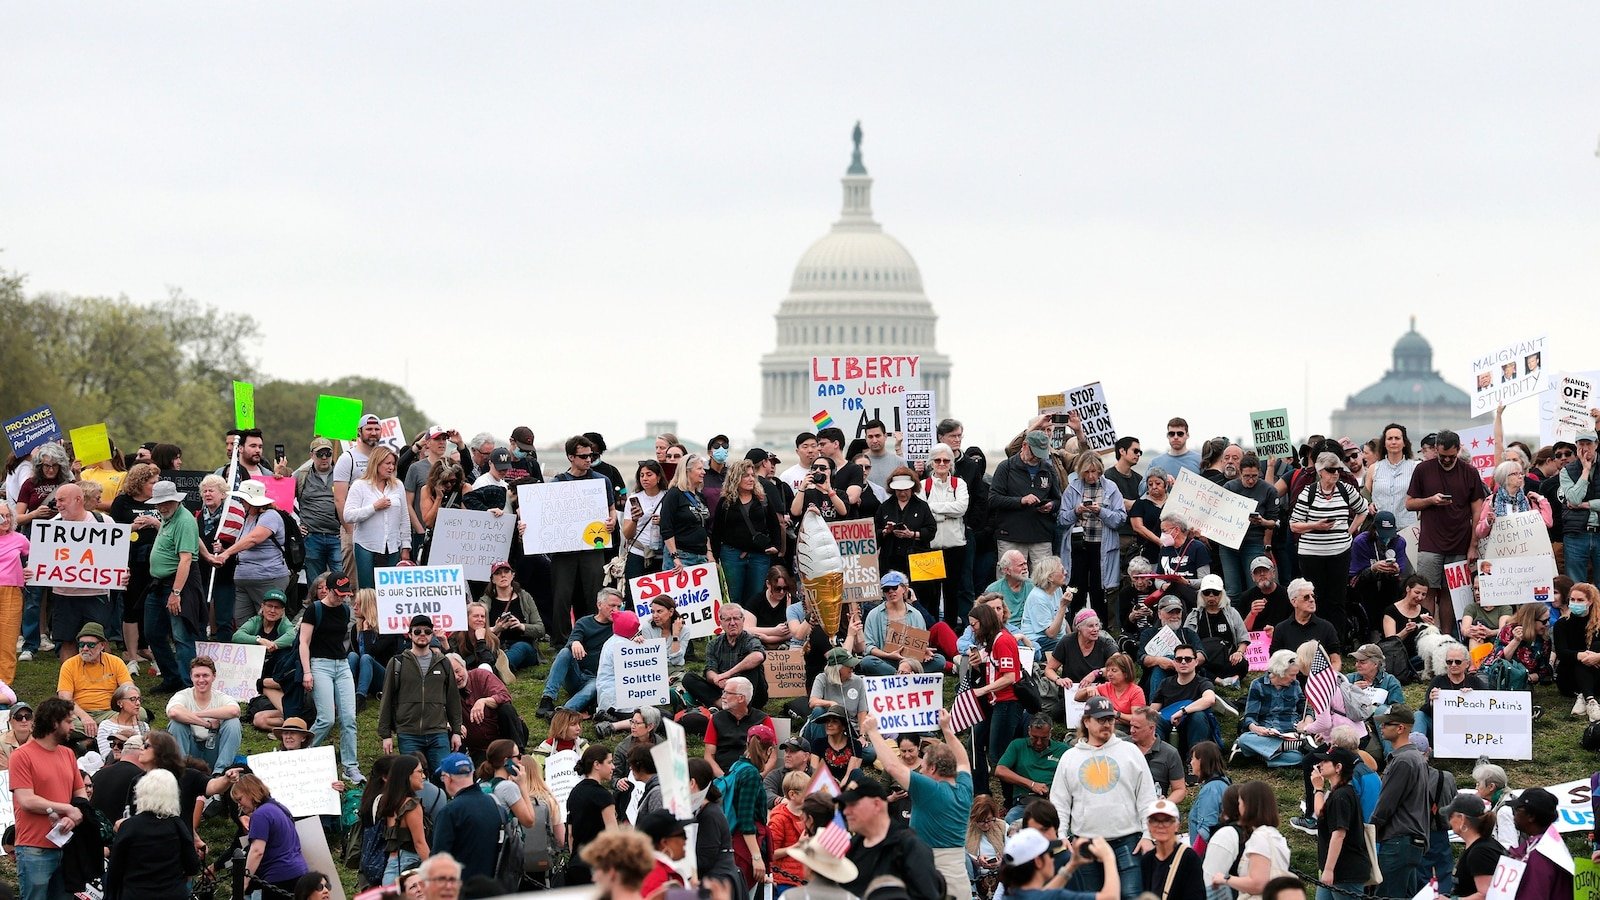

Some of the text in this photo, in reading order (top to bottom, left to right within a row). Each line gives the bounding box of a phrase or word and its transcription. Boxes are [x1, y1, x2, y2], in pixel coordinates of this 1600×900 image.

[1473, 336, 1546, 373] MALIGNANT
[812, 356, 920, 381] LIBERTY
[858, 381, 905, 396] Justice
[1476, 371, 1541, 409] STUPIDITY
[1564, 377, 1590, 389] HANDS
[1070, 387, 1095, 407] STOP
[1563, 386, 1589, 400] OFF
[907, 400, 929, 408] OFF!
[5, 408, 52, 433] PRO-CHOICE
[908, 423, 930, 432] OFF!
[1081, 415, 1112, 435] AR ON
[1253, 416, 1285, 430] WE NEED
[1254, 430, 1286, 443] FEDERAL
[1255, 442, 1289, 457] WORKERS
[1180, 470, 1197, 486] This
[1225, 496, 1237, 504] of
[1238, 500, 1249, 510] the
[1195, 490, 1220, 508] FREE
[443, 518, 505, 530] WHEN YOU PLAY
[1199, 505, 1212, 516] and
[1235, 515, 1245, 529] by
[36, 523, 124, 547] TRUMP
[446, 530, 476, 541] STUPID
[1523, 528, 1533, 537] IN
[460, 542, 496, 552] YOU WIN
[837, 539, 876, 556] ERVES
[54, 547, 94, 566] IS A
[445, 553, 476, 566] STUPID
[35, 564, 126, 586] FASCIST
[636, 567, 708, 600] STOP
[377, 585, 462, 598] IS OUR STRENGTH
[842, 586, 862, 600] ATTER
[1492, 588, 1522, 597] terminal
[395, 601, 442, 615] STAND
[387, 614, 453, 630] UNED
[891, 630, 926, 650] RESIST
[620, 644, 661, 656] So many
[767, 651, 791, 663] Stop
[622, 673, 662, 685] So little
[866, 676, 942, 692] IS THIS WHAT
[873, 690, 934, 713] GREAT
[1098, 700, 1109, 709] W
[1444, 695, 1522, 711] imPeach Putin's
[877, 714, 909, 730] OOKS
[551, 770, 577, 779] HANDS
